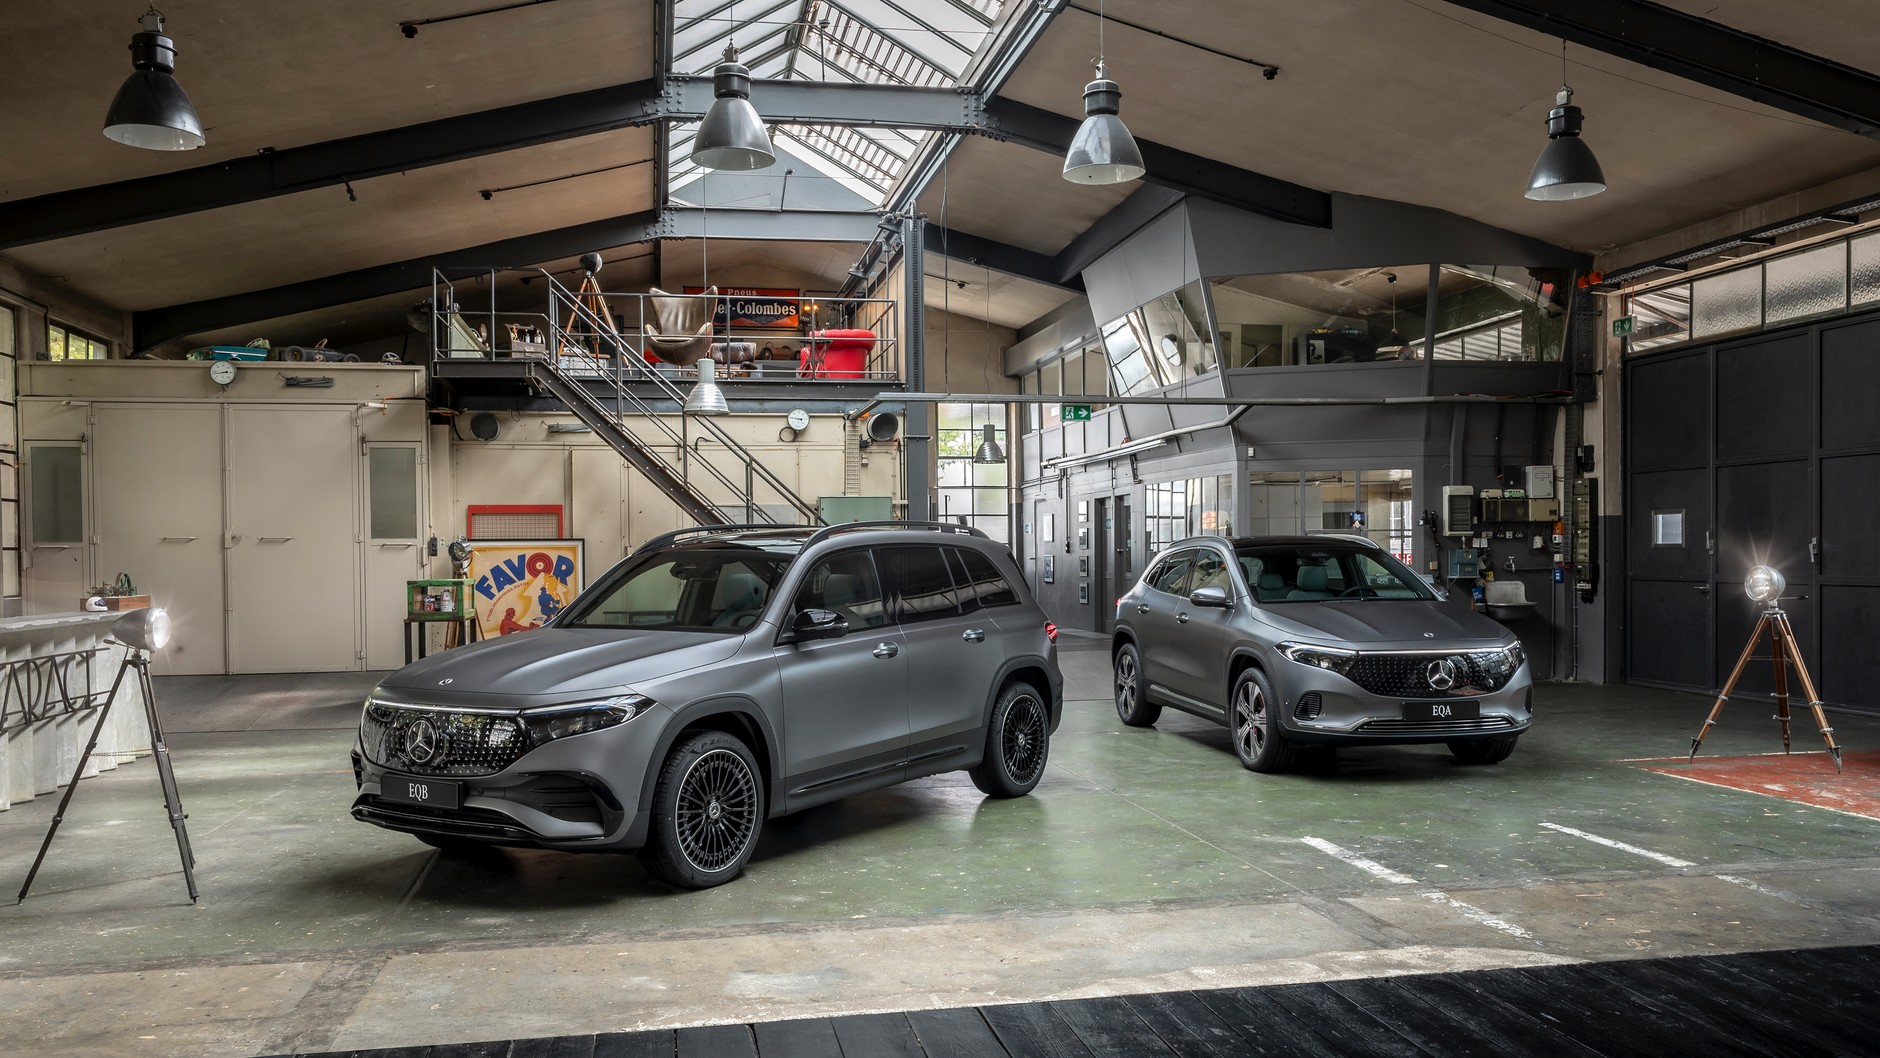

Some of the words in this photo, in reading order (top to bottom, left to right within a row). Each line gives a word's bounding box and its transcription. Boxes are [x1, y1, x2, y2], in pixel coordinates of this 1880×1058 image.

[727, 288, 757, 297] Pneus
[715, 301, 797, 316] er-Colombes
[475, 552, 575, 601] FAVOR
[1432, 705, 1452, 717] EQA
[408, 783, 428, 801] EQB
